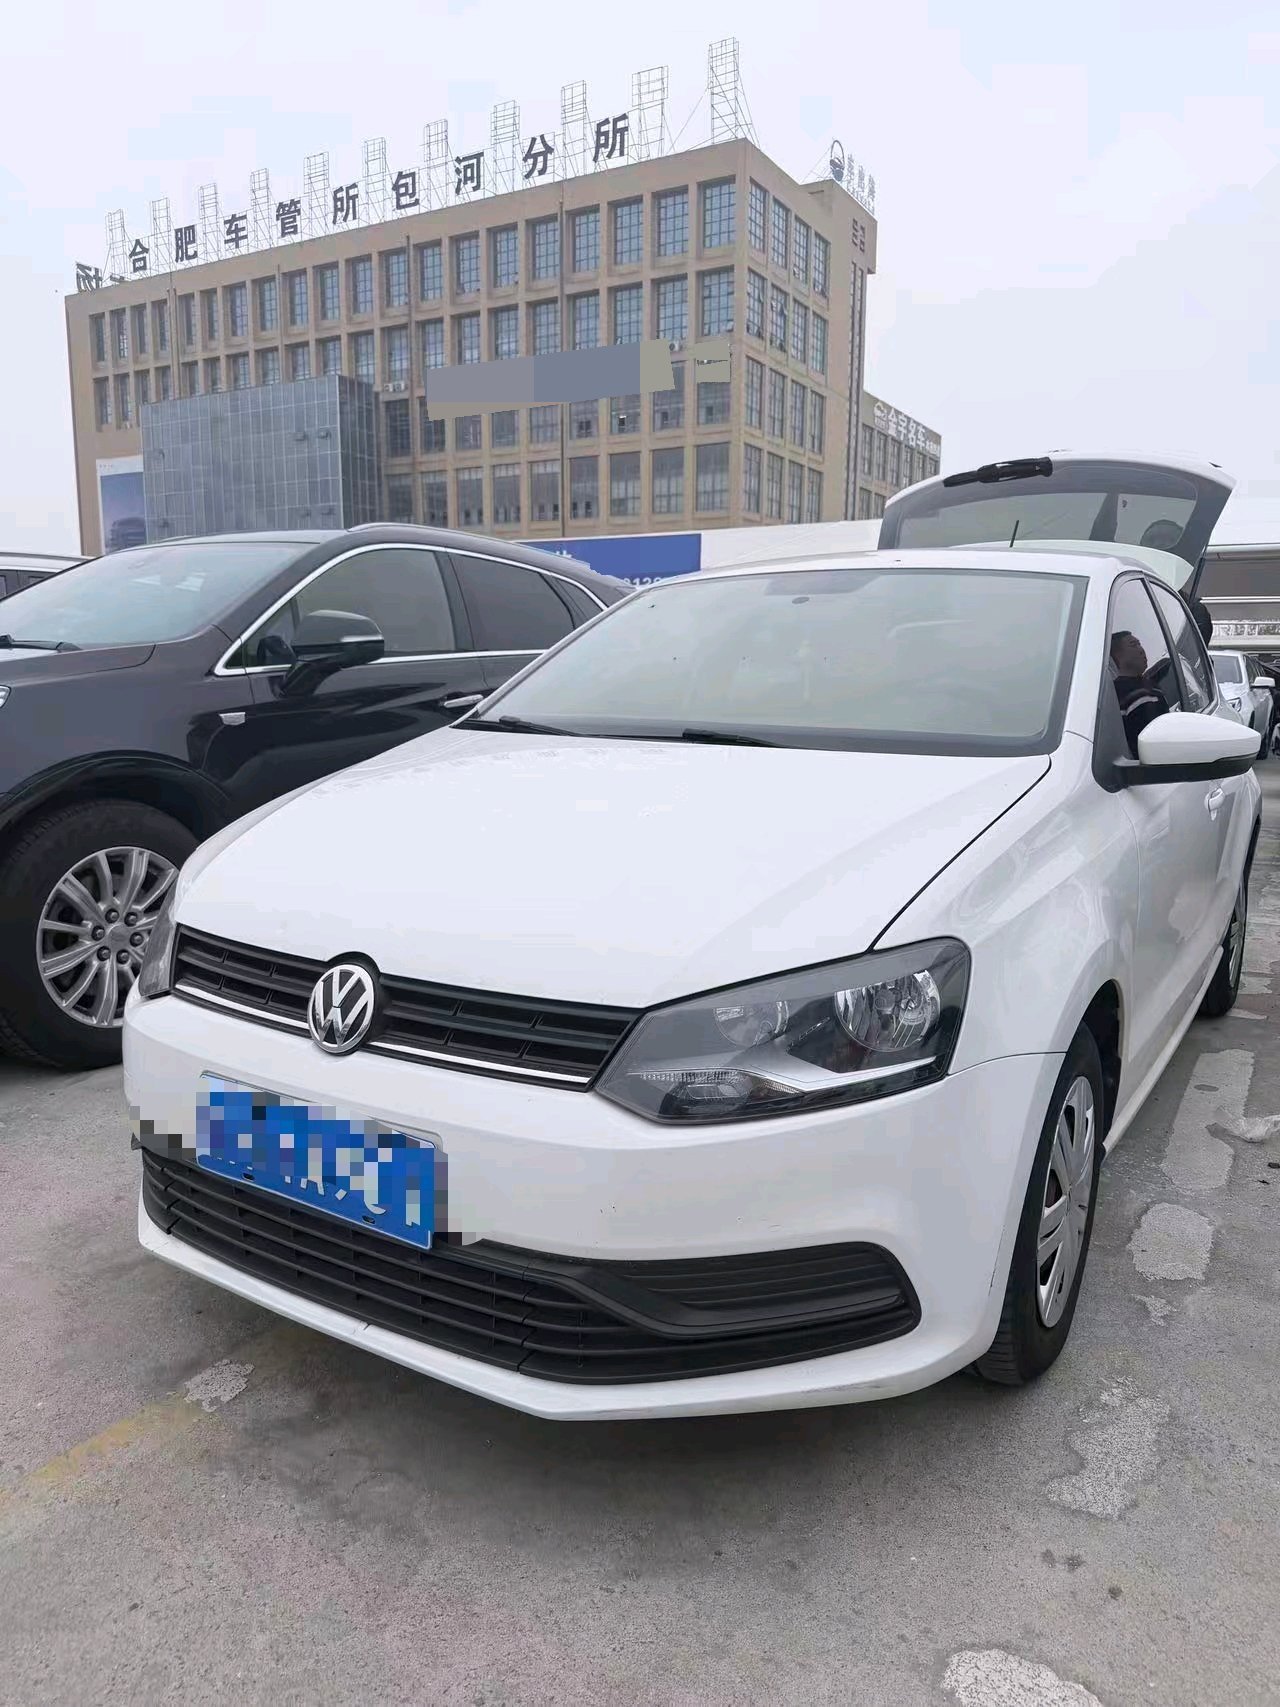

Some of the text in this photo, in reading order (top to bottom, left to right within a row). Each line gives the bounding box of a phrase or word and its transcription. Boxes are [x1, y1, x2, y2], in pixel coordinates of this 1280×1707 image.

[128, 112, 629, 274] 合肥车管所包河分所
